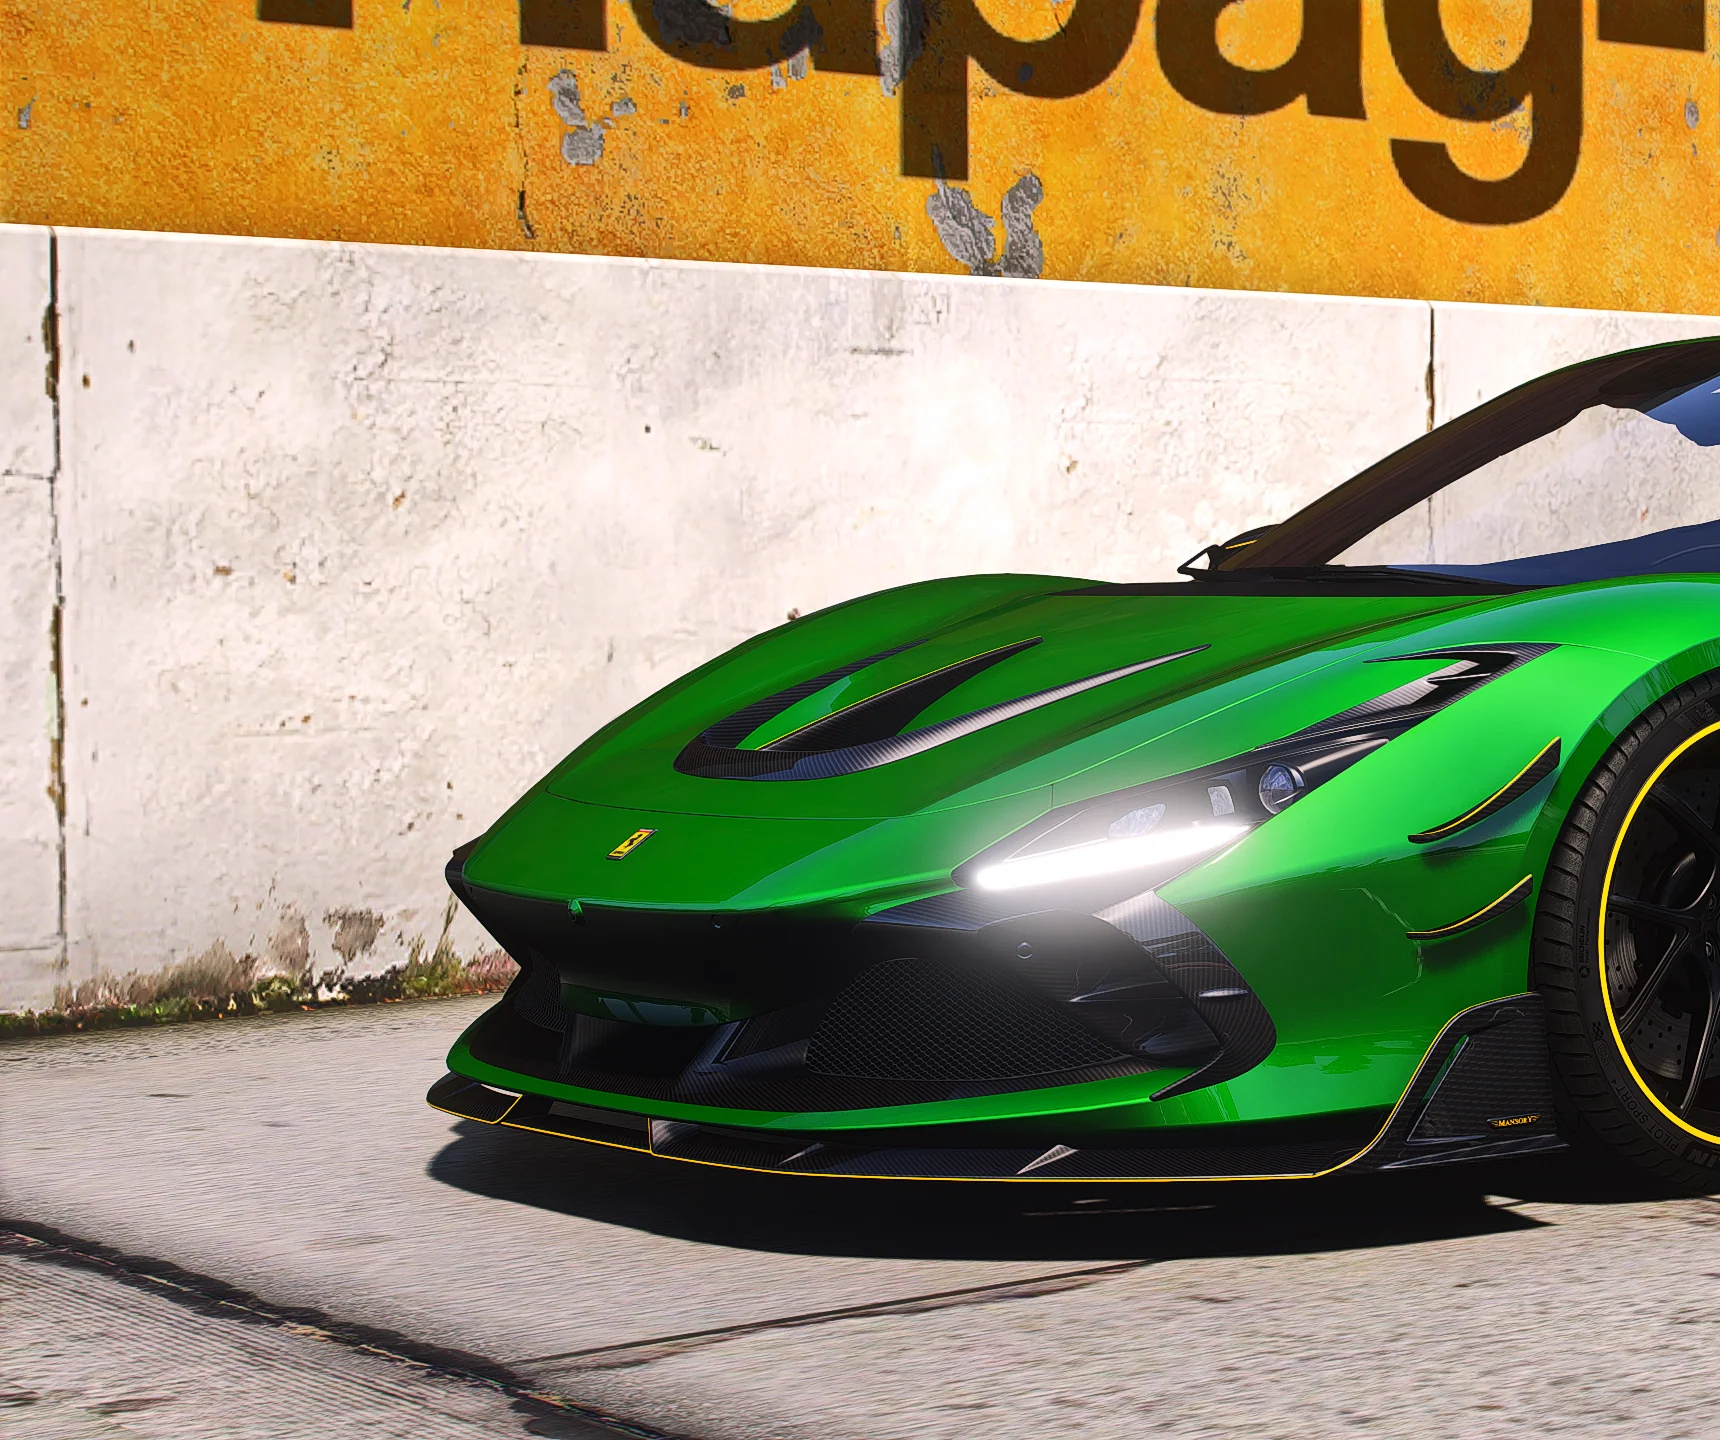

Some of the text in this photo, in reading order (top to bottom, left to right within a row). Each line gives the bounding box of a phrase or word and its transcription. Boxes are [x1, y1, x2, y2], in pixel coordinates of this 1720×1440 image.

[1615, 1083, 1649, 1124] SPORT
[1498, 1115, 1533, 1127] MANSORY
[1646, 1125, 1680, 1151] PILOT
